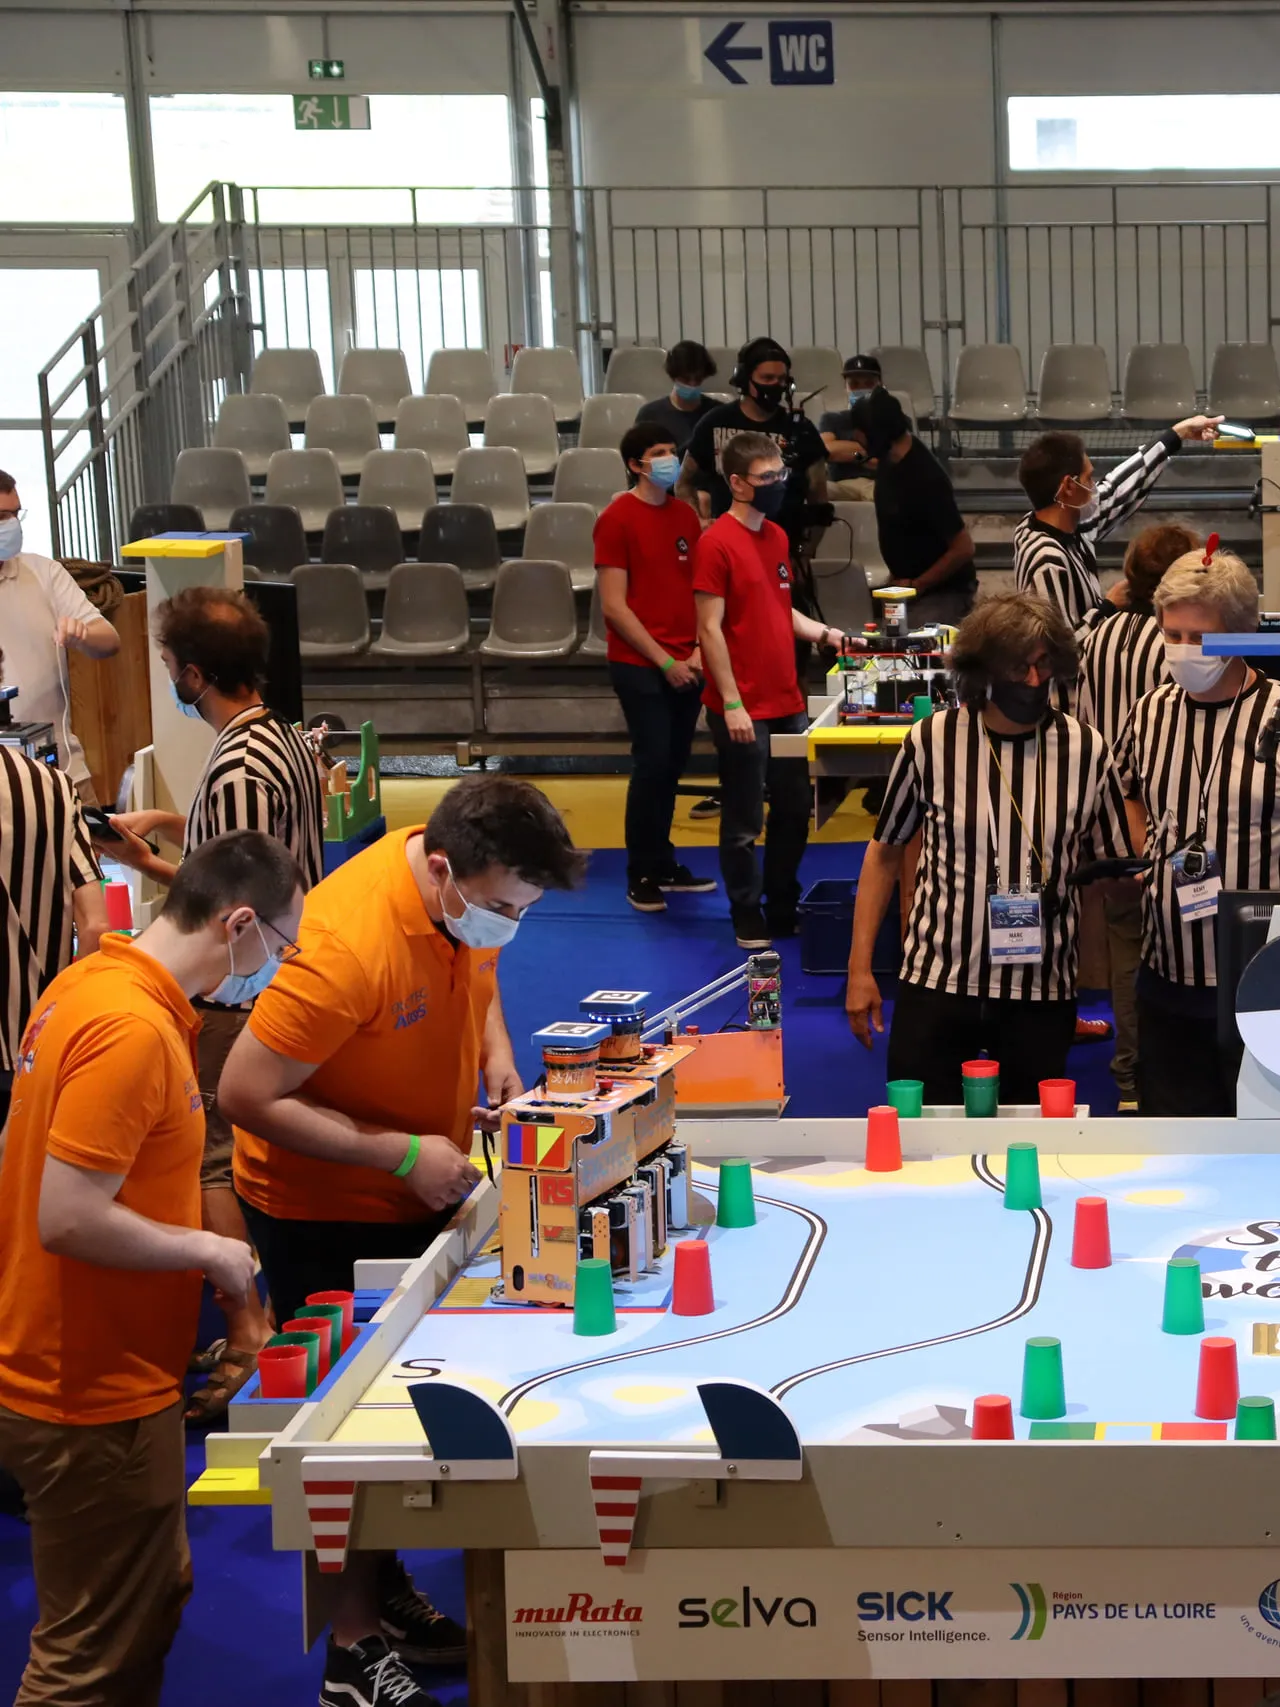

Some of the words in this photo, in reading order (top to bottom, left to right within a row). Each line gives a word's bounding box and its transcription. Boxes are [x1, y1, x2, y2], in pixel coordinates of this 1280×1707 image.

[778, 33, 826, 73] WC
[542, 1177, 573, 1204] RS
[391, 1358, 447, 1379] S
[857, 1591, 954, 1621] SICK
[1052, 1591, 1083, 1601] Région
[512, 1593, 644, 1624] muRata
[678, 1586, 816, 1628] selva
[1052, 1603, 1099, 1620] PAYS
[1104, 1603, 1129, 1620] DE
[1134, 1603, 1157, 1620] LA
[1163, 1602, 1216, 1619] LOIRE
[515, 1630, 567, 1638] INNOVATOR
[582, 1629, 640, 1637] ELECTRONICS
[1240, 1614, 1255, 1633] une
[857, 1630, 905, 1642] Sensor
[909, 1629, 990, 1643] Intelligence.
